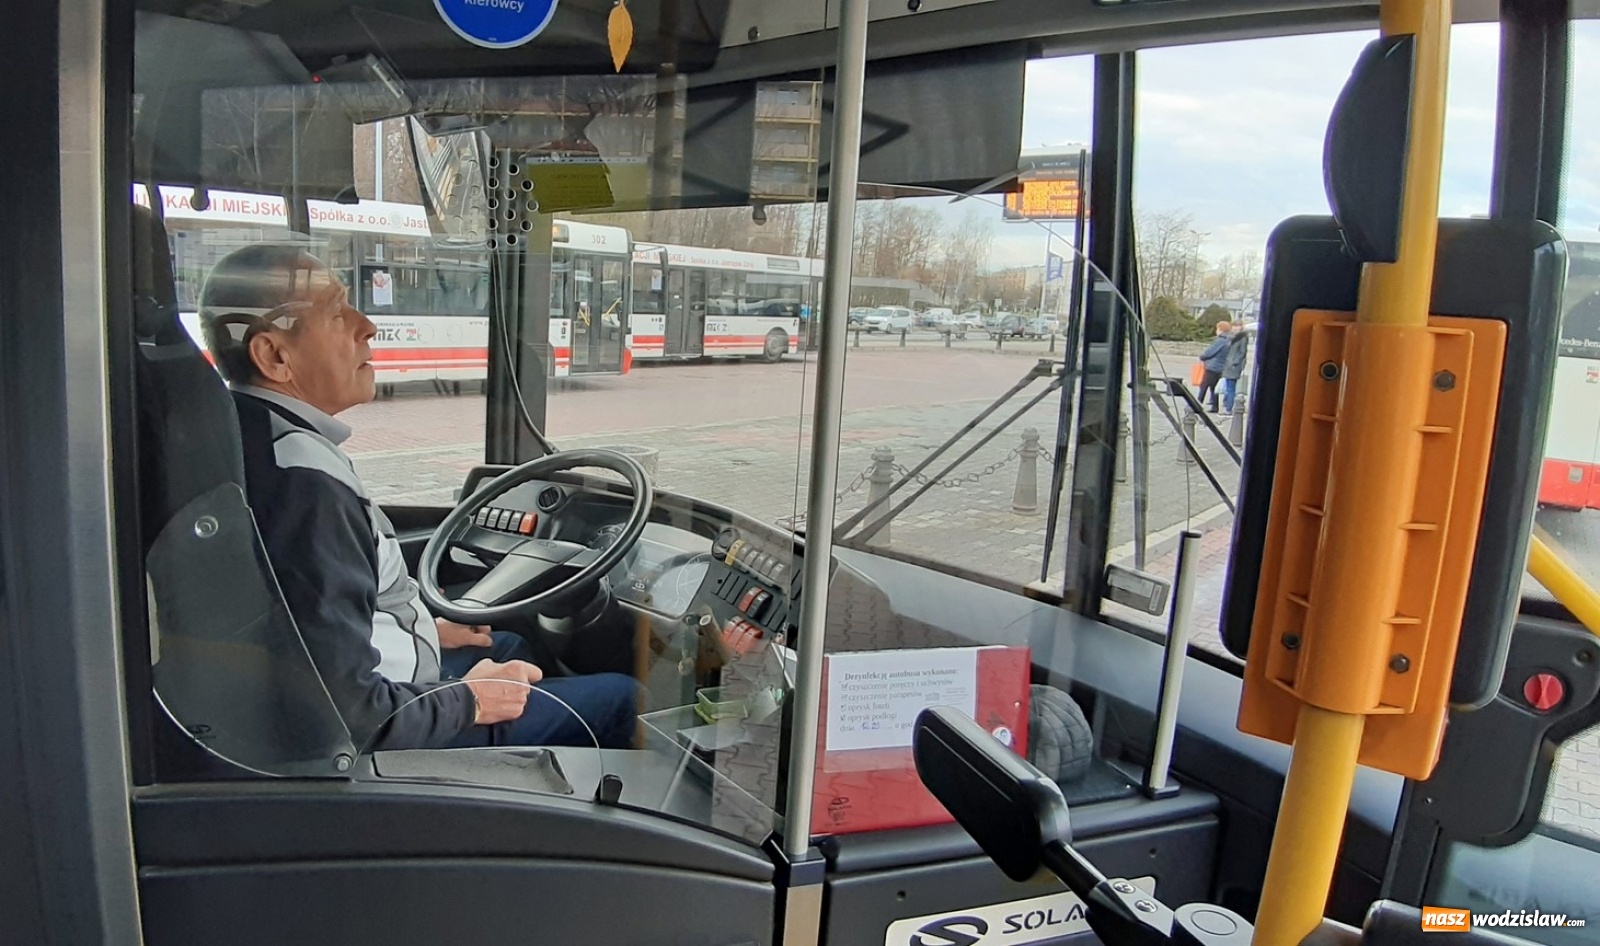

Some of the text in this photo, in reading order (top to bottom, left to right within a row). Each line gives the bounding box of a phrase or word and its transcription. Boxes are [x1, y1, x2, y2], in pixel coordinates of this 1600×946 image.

[310, 207, 427, 229] Spółka z o.o. Jast
[591, 234, 607, 245] 302
[844, 672, 887, 682] Dezynfekcję
[889, 670, 921, 678] autobusu
[901, 722, 913, 730] god
[1002, 903, 1086, 934] SOLA
